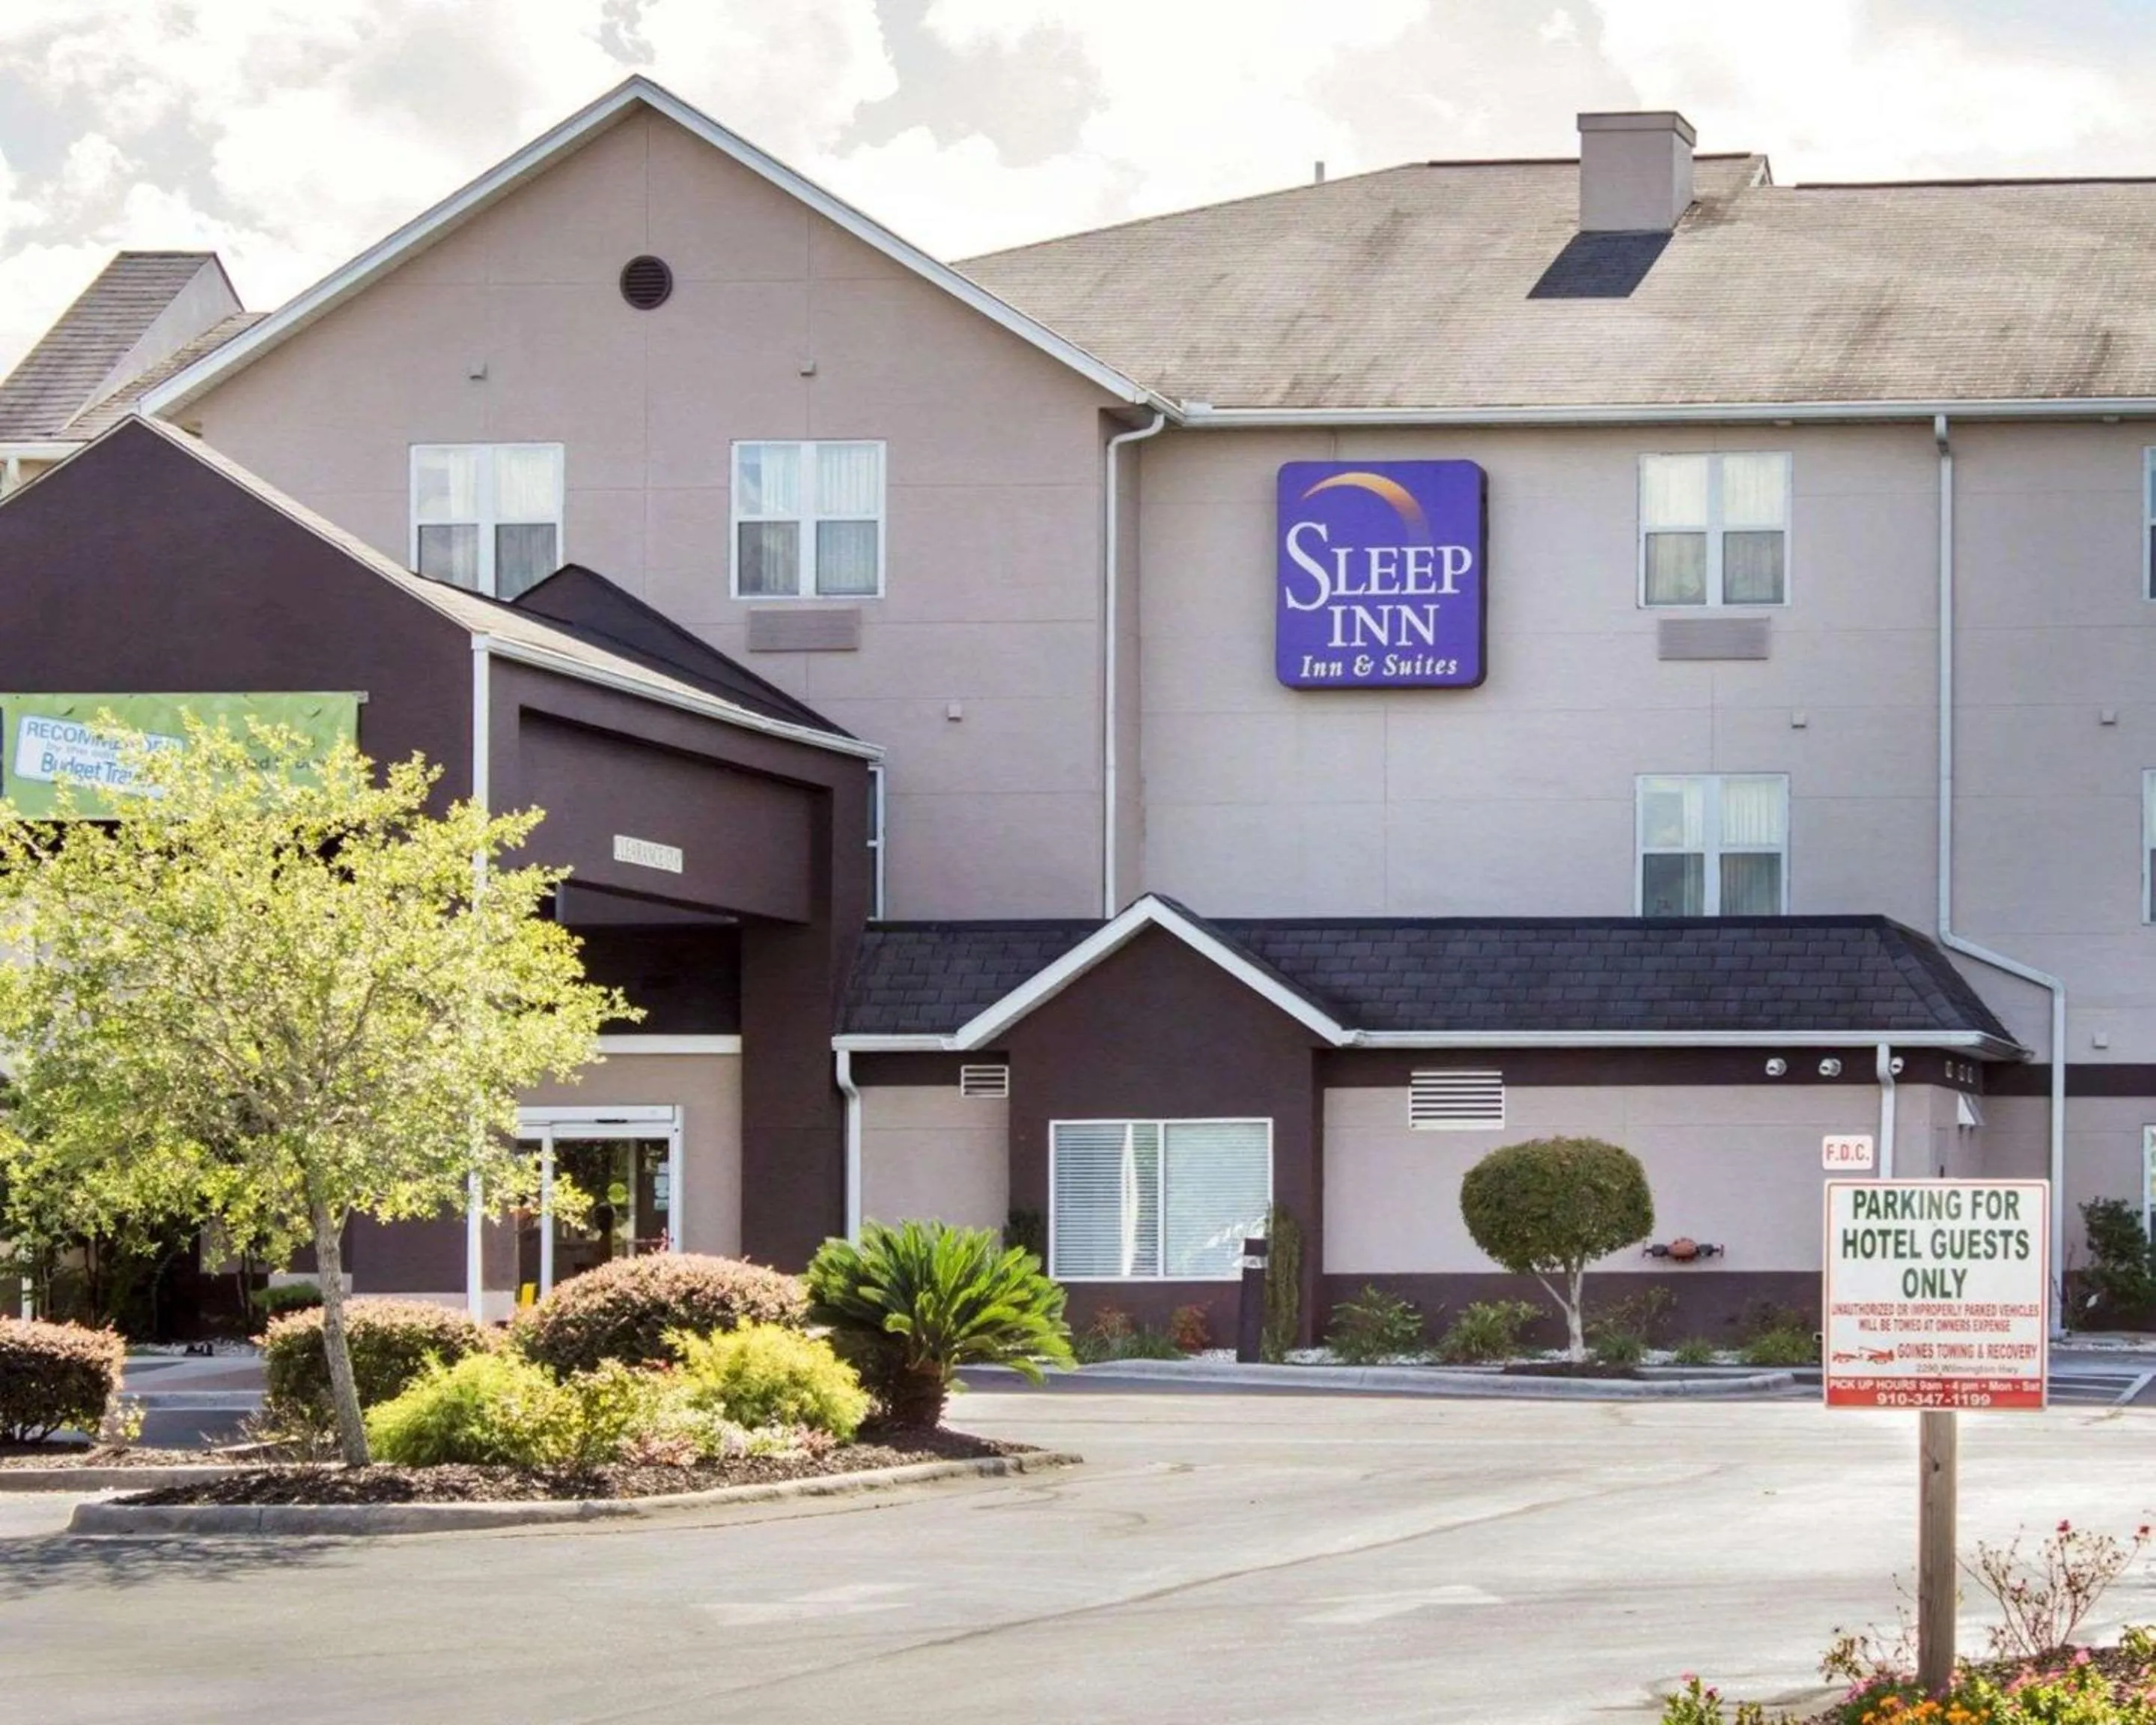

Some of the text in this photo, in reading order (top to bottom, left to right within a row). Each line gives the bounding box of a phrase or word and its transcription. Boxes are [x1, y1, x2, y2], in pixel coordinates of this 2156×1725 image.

[1285, 521, 1473, 611] SLEEP
[1327, 604, 1440, 648] INN
[1300, 654, 1458, 678] Inn & Suites
[41, 751, 102, 780] Budget
[1826, 1143, 1870, 1161] F.D.C.
[1852, 1189, 2021, 1221] PARKING FOR
[1842, 1229, 2030, 1261] HOTEL GUESTS
[1902, 1268, 1967, 1299] ONLY
[1832, 1303, 2039, 1317] UNAUTHORIZED OR IMPROPERLY PARKED VEHICLES
[1859, 1318, 2011, 1333] WILL BE TOWED AT OWNERS EXPENSE
[1937, 1343, 1975, 1359] TOWING
[1977, 1344, 1984, 1359] &
[1987, 1344, 2038, 1360] RECOVERY
[1829, 1379, 1854, 1390] PICK
[1858, 1380, 1874, 1390] UP
[1877, 1380, 1916, 1391] HOURS
[1988, 1381, 2012, 1391] Mon
[1877, 1393, 1991, 1405] 910-347-1199
